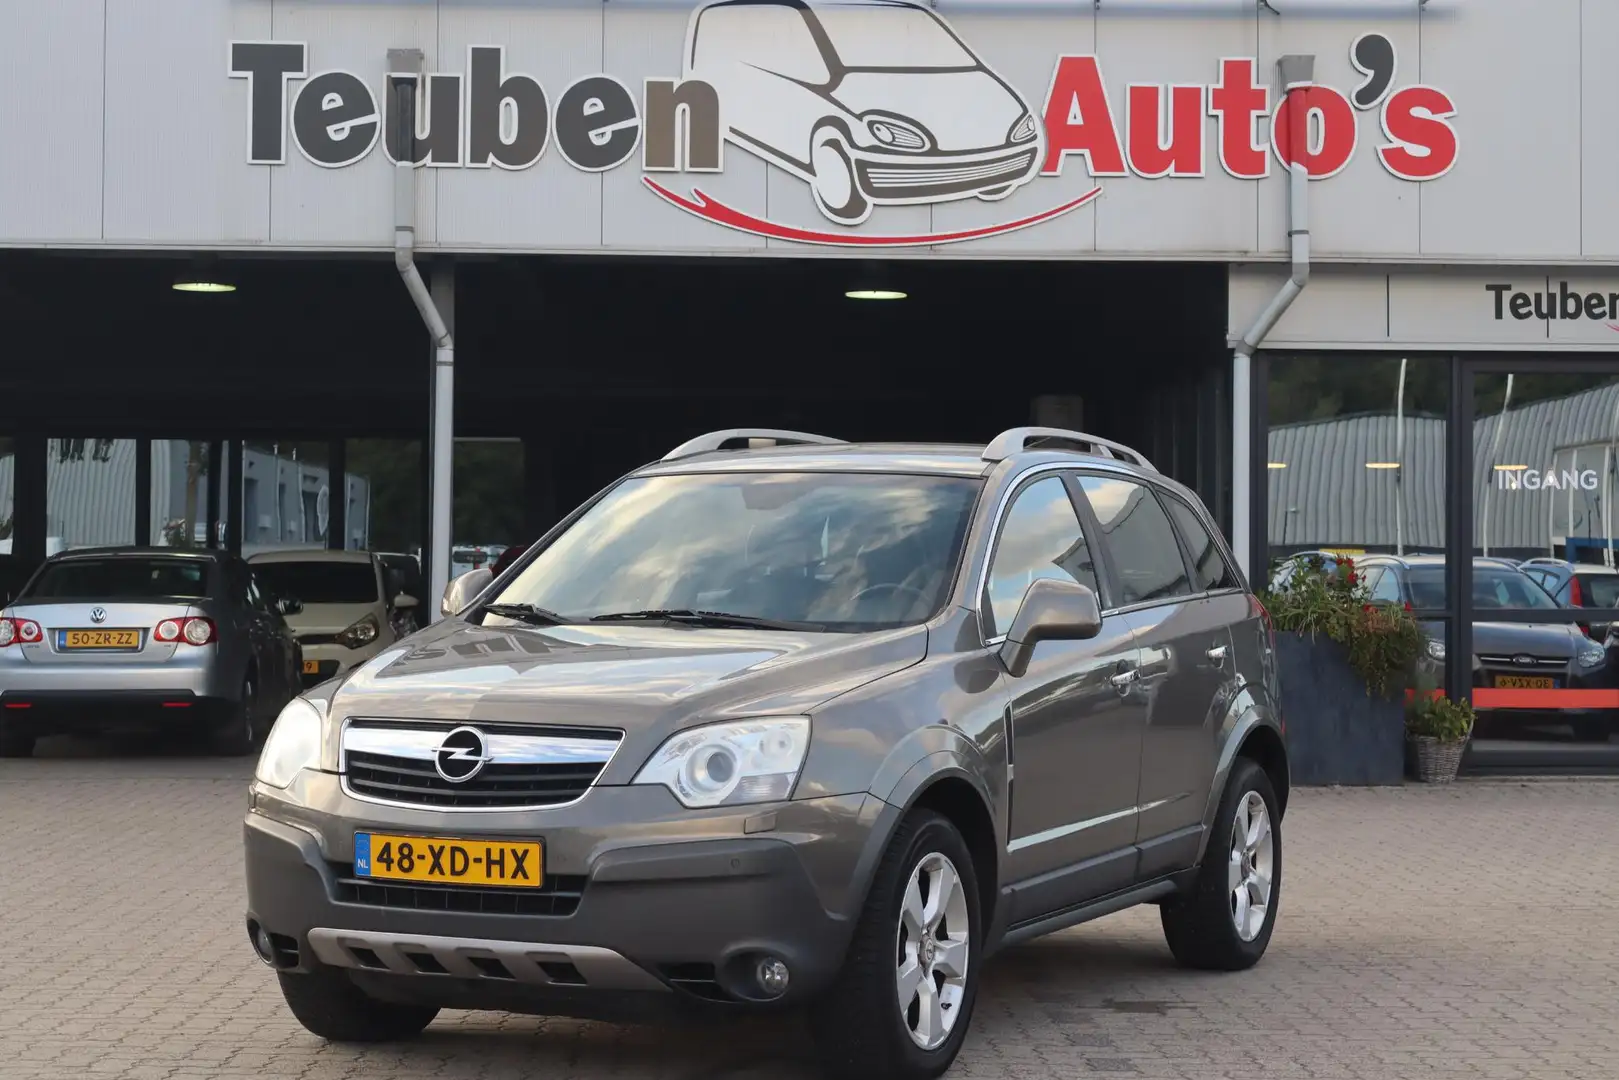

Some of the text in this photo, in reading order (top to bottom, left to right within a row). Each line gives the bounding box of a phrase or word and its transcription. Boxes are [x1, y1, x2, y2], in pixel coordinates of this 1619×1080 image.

[229, 32, 1459, 181] Teuben Auto's
[1498, 469, 1598, 490] INGANG
[71, 632, 133, 645] 50-ZR-ZZ
[357, 858, 369, 869] NL
[376, 841, 530, 880] 48-XD-HX
